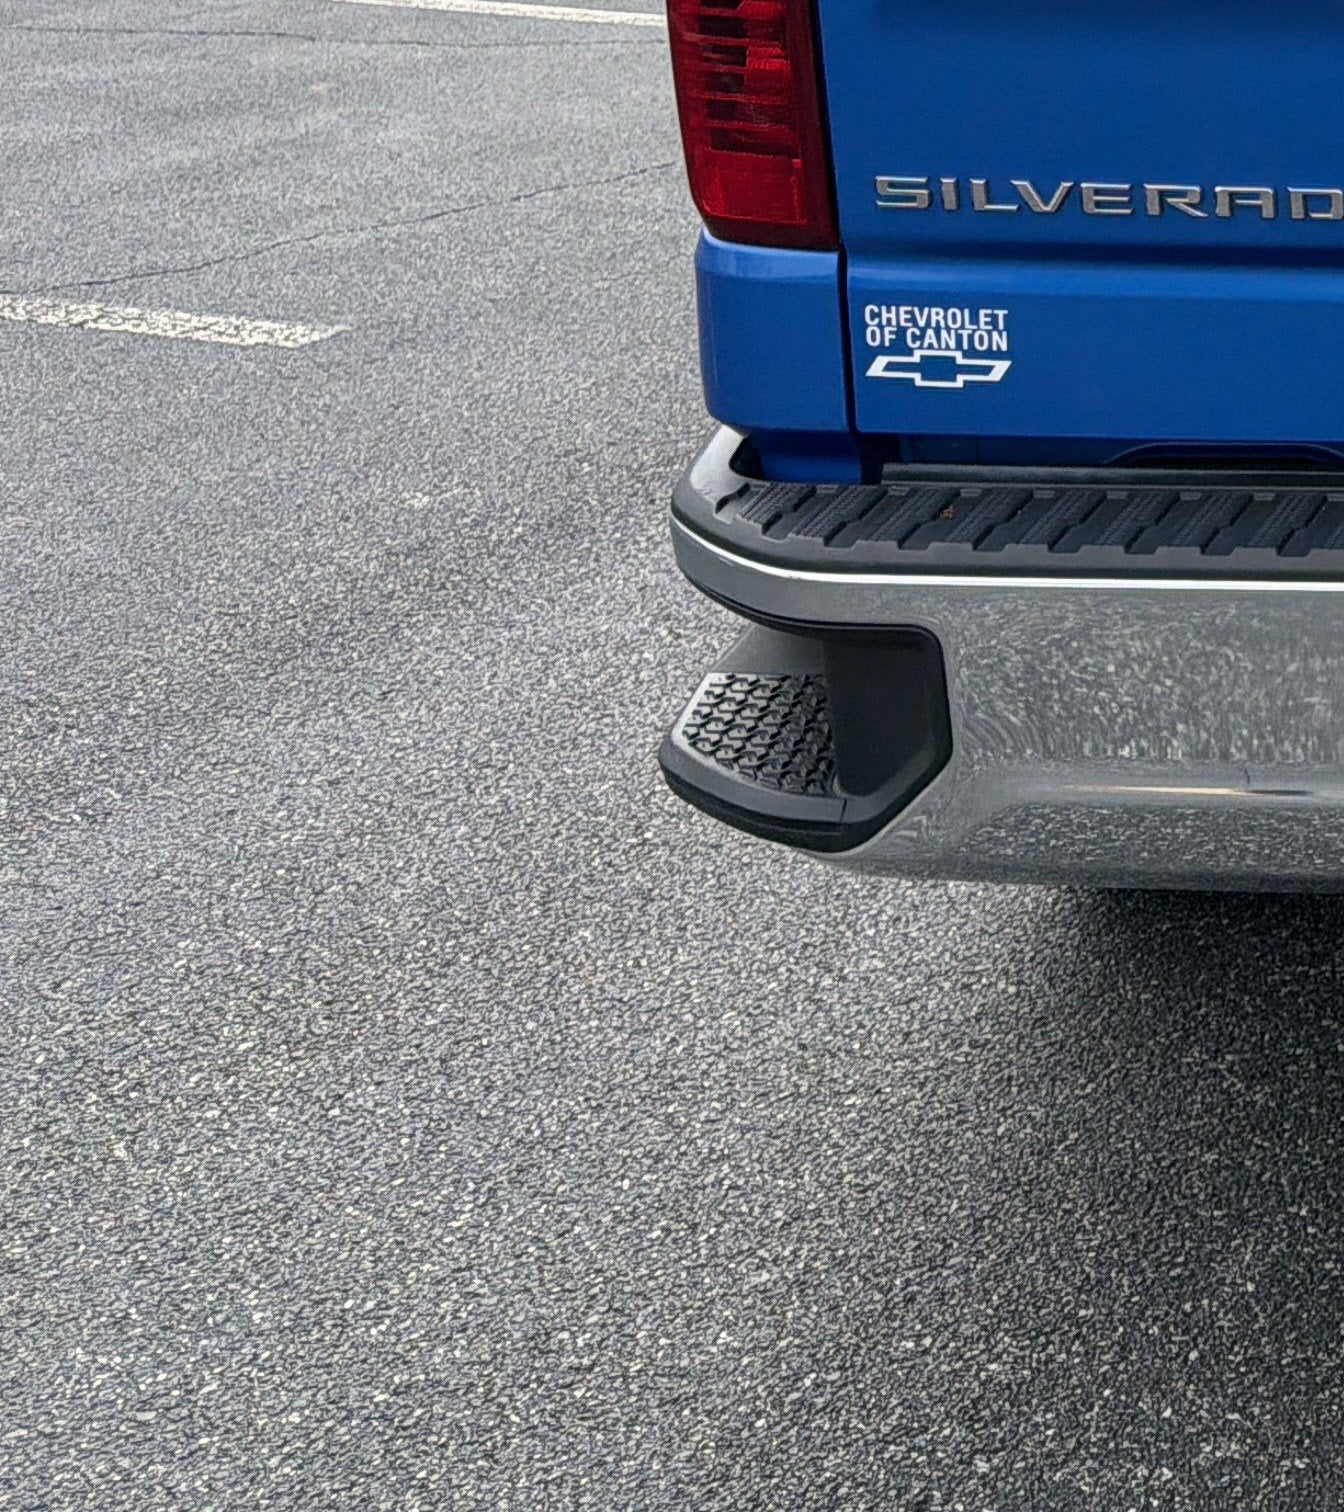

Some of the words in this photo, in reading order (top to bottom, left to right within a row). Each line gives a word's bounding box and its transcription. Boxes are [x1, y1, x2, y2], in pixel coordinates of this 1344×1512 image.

[864, 304, 1008, 330] CHEVROLET
[865, 326, 896, 348] OF
[905, 328, 1008, 352] CANTON
